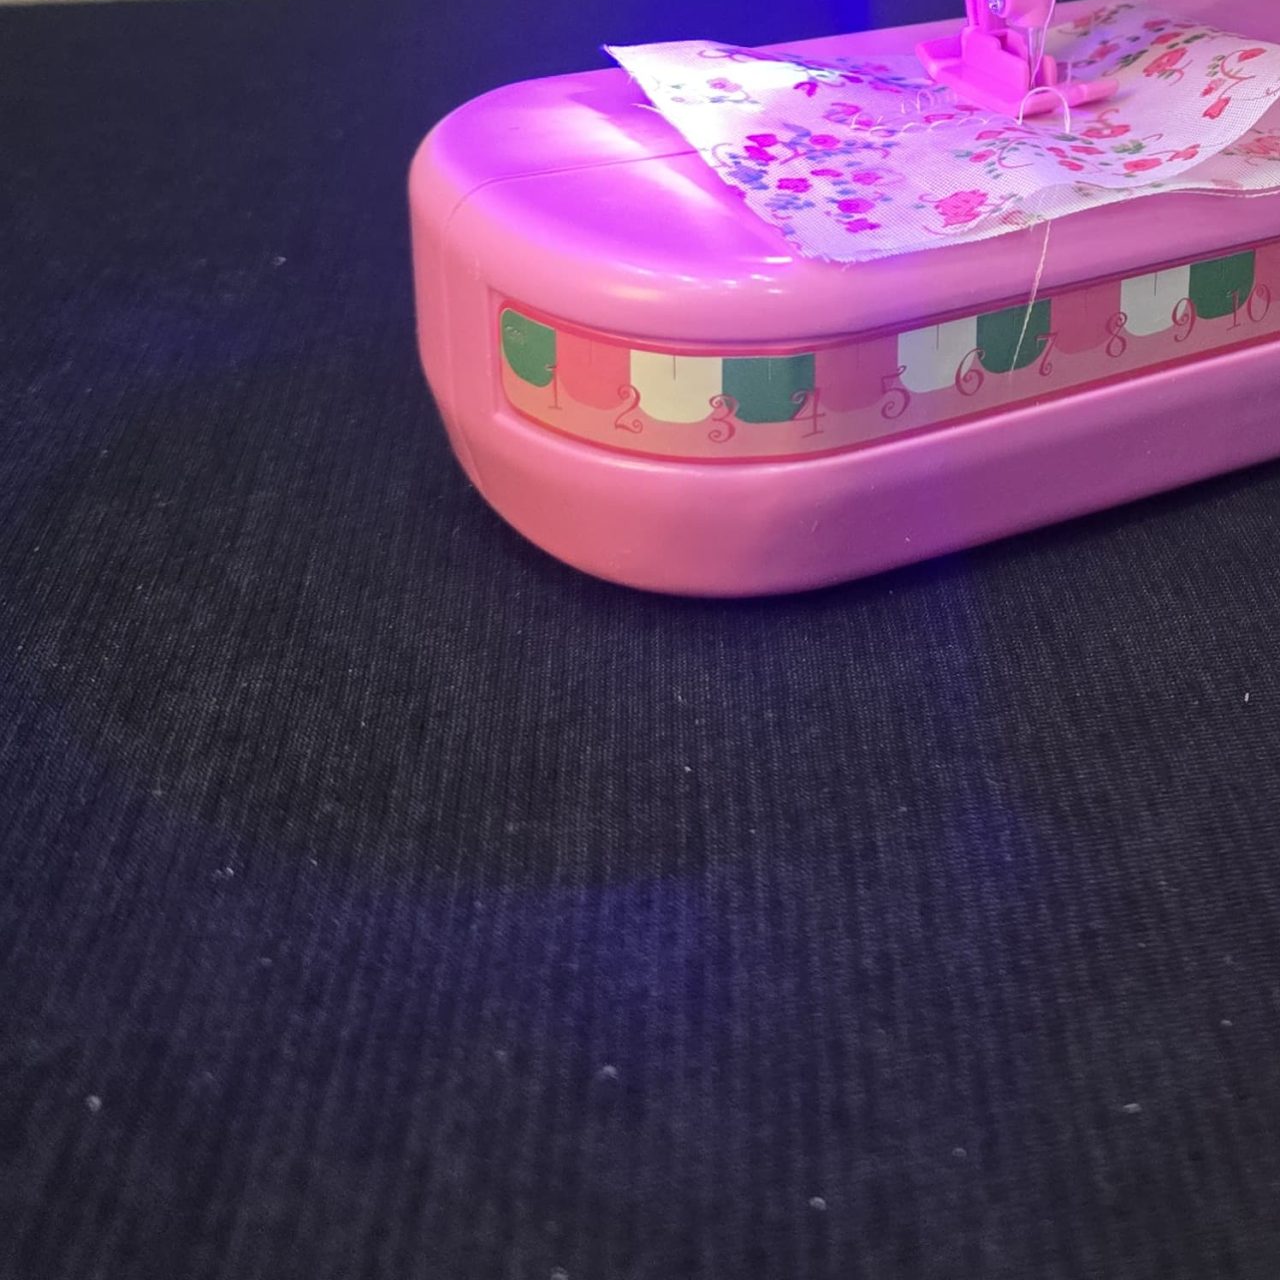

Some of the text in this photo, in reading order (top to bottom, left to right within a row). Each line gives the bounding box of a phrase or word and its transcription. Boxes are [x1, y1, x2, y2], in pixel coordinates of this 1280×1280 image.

[615, 384, 643, 434] 2
[708, 394, 739, 443] 3
[791, 387, 826, 438] 4
[881, 365, 911, 420] 5
[955, 347, 985, 397] 6
[1034, 332, 1058, 376] 7
[1105, 311, 1128, 358] 8
[1171, 297, 1197, 343] 9
[1226, 284, 1271, 331] 10
